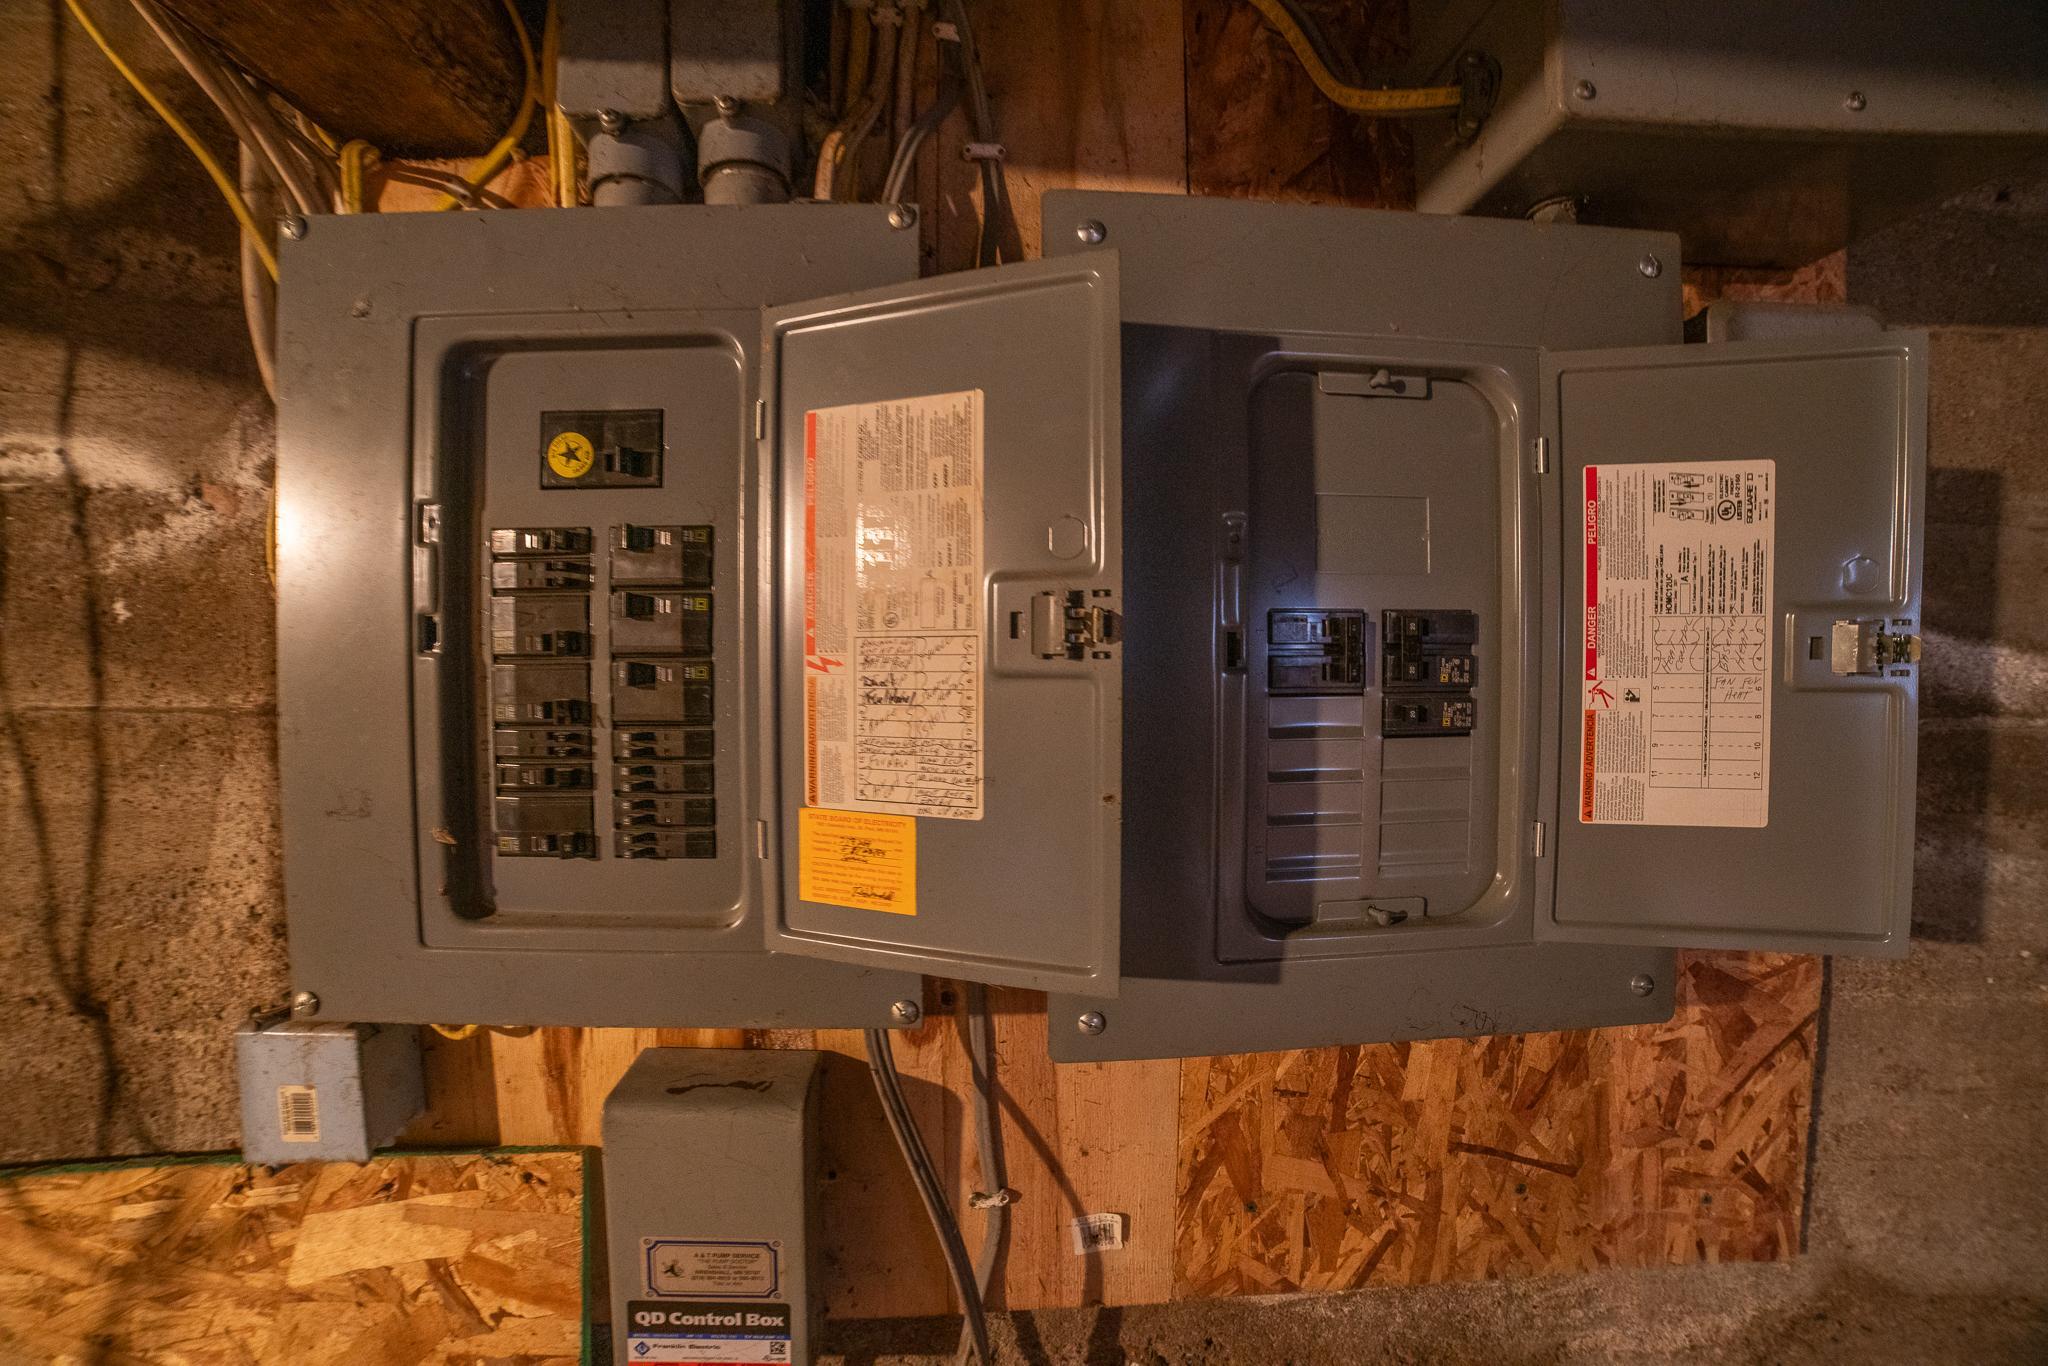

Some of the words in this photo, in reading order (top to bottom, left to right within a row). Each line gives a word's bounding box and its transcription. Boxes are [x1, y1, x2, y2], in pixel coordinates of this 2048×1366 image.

[1747, 473, 1753, 482] D
[1588, 500, 1596, 544] PELIGRO
[1588, 606, 1596, 649] DANGER
[808, 678, 817, 794] WARNING/ADVERTENCIA
[1586, 714, 1594, 766] ADVERTENCIA
[1754, 742, 1760, 750] 10
[1584, 772, 1593, 808] WARNING
[1754, 772, 1760, 780] 12
[634, 1311, 666, 1326] QD
[669, 1312, 741, 1326] Control
[745, 1313, 784, 1326] Box
